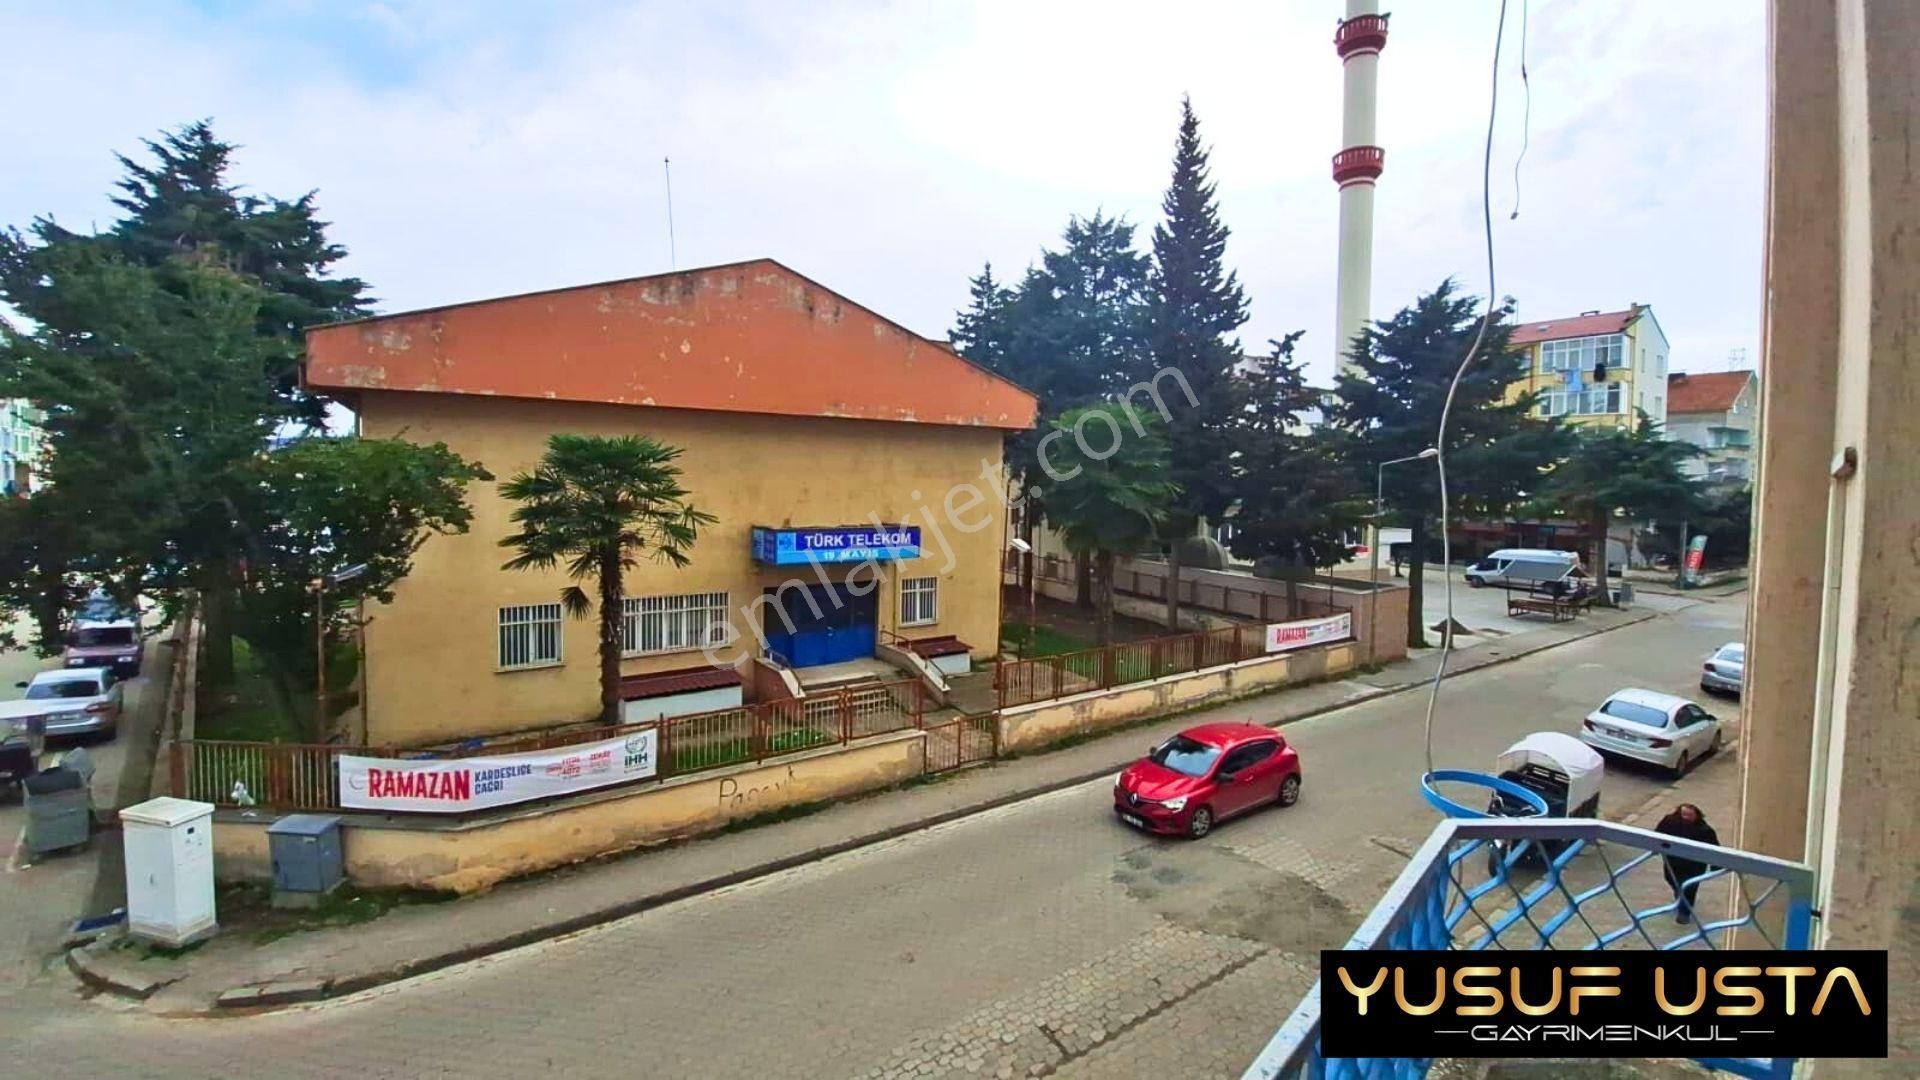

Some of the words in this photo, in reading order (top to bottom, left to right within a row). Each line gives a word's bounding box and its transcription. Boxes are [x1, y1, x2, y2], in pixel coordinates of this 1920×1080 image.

[804, 533, 844, 547] TÜRK
[849, 532, 912, 546] TELEKOM
[368, 767, 470, 800] RAMAZAN
